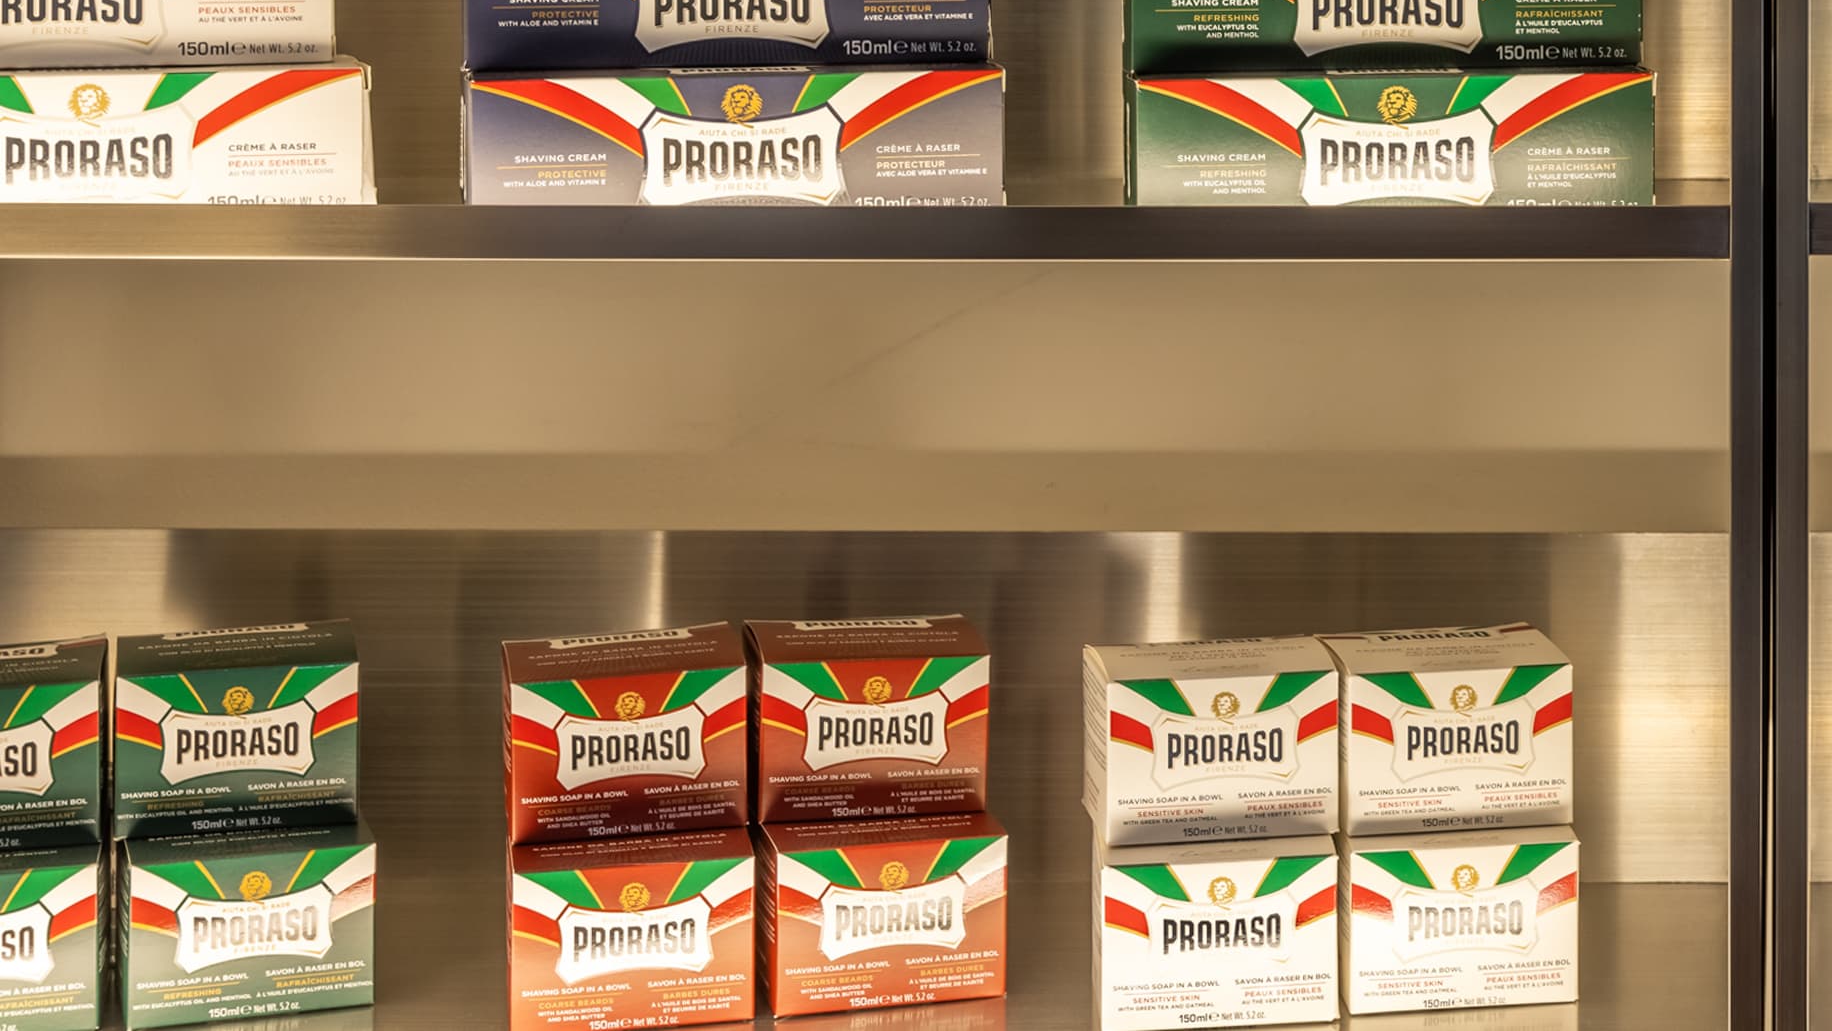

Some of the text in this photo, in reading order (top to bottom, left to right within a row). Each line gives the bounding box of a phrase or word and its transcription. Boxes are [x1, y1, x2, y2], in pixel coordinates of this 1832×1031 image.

[864, 4, 932, 13] PROTECTEUR
[1171, 0, 1219, 8] SHAVING
[198, 6, 296, 15] PEAUX SENSIBLES
[532, 11, 600, 20] PROTECTIVE
[498, 20, 519, 28] WITH
[1194, 14, 1259, 22] REFRESHING
[1176, 23, 1245, 32] WITH EUCALYPTUS
[1224, 31, 1259, 39] MENTHOL
[249, 41, 302, 54] Net 5.2
[911, 41, 960, 53] Net 5.2
[1562, 47, 1611, 59] Net 5.2
[280, 142, 317, 151] RASER
[925, 142, 961, 152] RASER
[1577, 146, 1610, 155] RASER
[5, 133, 173, 186] PRORASO
[514, 153, 607, 163] SHAVING CREAM
[662, 134, 824, 187] PRORASO
[876, 159, 946, 169] PROTECTEUR
[1177, 153, 1266, 163] SHAVING CREAM
[1320, 135, 1475, 187] PRORASO
[537, 170, 607, 179] PROTECTIVE
[818, 711, 934, 751] PRORASO
[176, 720, 299, 765] PRORASO
[1407, 720, 1519, 761] PRORASO
[571, 725, 690, 770] PRORASO
[1168, 727, 1283, 769] PRORASO
[848, 770, 873, 780] BOWL
[248, 782, 277, 791] SAVON
[287, 779, 314, 788] RASER
[316, 778, 327, 786] EN
[328, 777, 347, 786] BOL
[120, 790, 159, 799] SHAVING
[160, 788, 184, 797] SOAP
[205, 785, 231, 794] BOWL
[1238, 791, 1265, 800] SAVON
[1276, 789, 1302, 798] RASER
[1304, 788, 1315, 796] EN
[1316, 787, 1332, 795] BOL
[1118, 797, 1153, 806] SHAVING
[1155, 795, 1177, 804] SOAP
[1179, 794, 1188, 802] IN
[1198, 793, 1223, 802] BOWL
[1276, 801, 1322, 810] SENSIBLES
[836, 896, 953, 942] PRORASO
[1408, 900, 1523, 943] PRORASO
[193, 905, 317, 954] PRORASO
[1163, 912, 1281, 955] PRORASO
[573, 917, 696, 963] PRORASO
